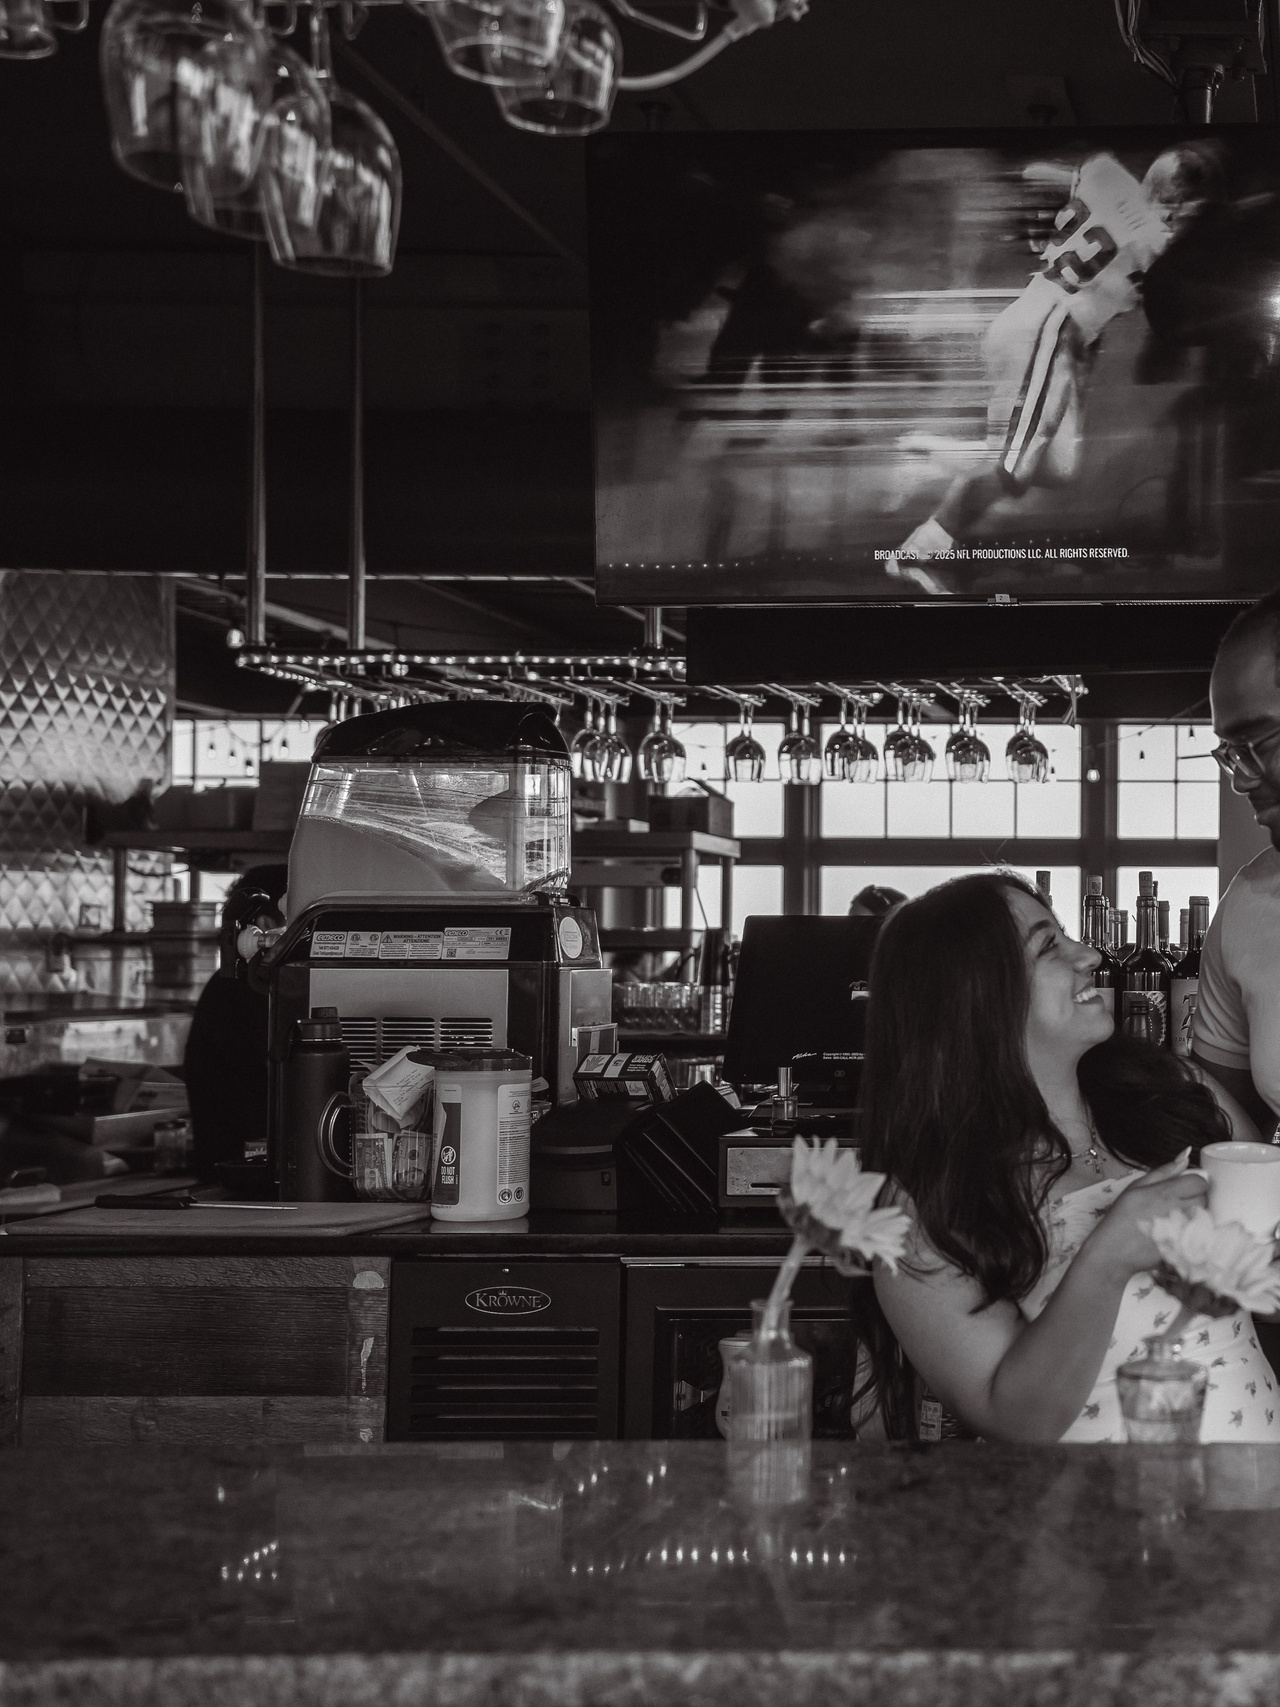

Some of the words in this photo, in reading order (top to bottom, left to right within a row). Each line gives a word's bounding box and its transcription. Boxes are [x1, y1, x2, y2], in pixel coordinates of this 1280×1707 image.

[874, 549, 920, 560] BROADCAST
[934, 549, 955, 559] 2025
[956, 549, 970, 559] NFL
[972, 549, 1026, 559] PRODUCTIONS
[1027, 549, 1043, 558] LLC.
[1045, 549, 1058, 558] ALL
[1059, 548, 1087, 558] RIGHTS
[1089, 548, 1130, 558] RESERVED.
[441, 1166, 447, 1175] DO
[447, 1166, 455, 1175] NOT
[441, 1176, 454, 1184] FLUSH
[475, 1292, 542, 1308] KROWNE
